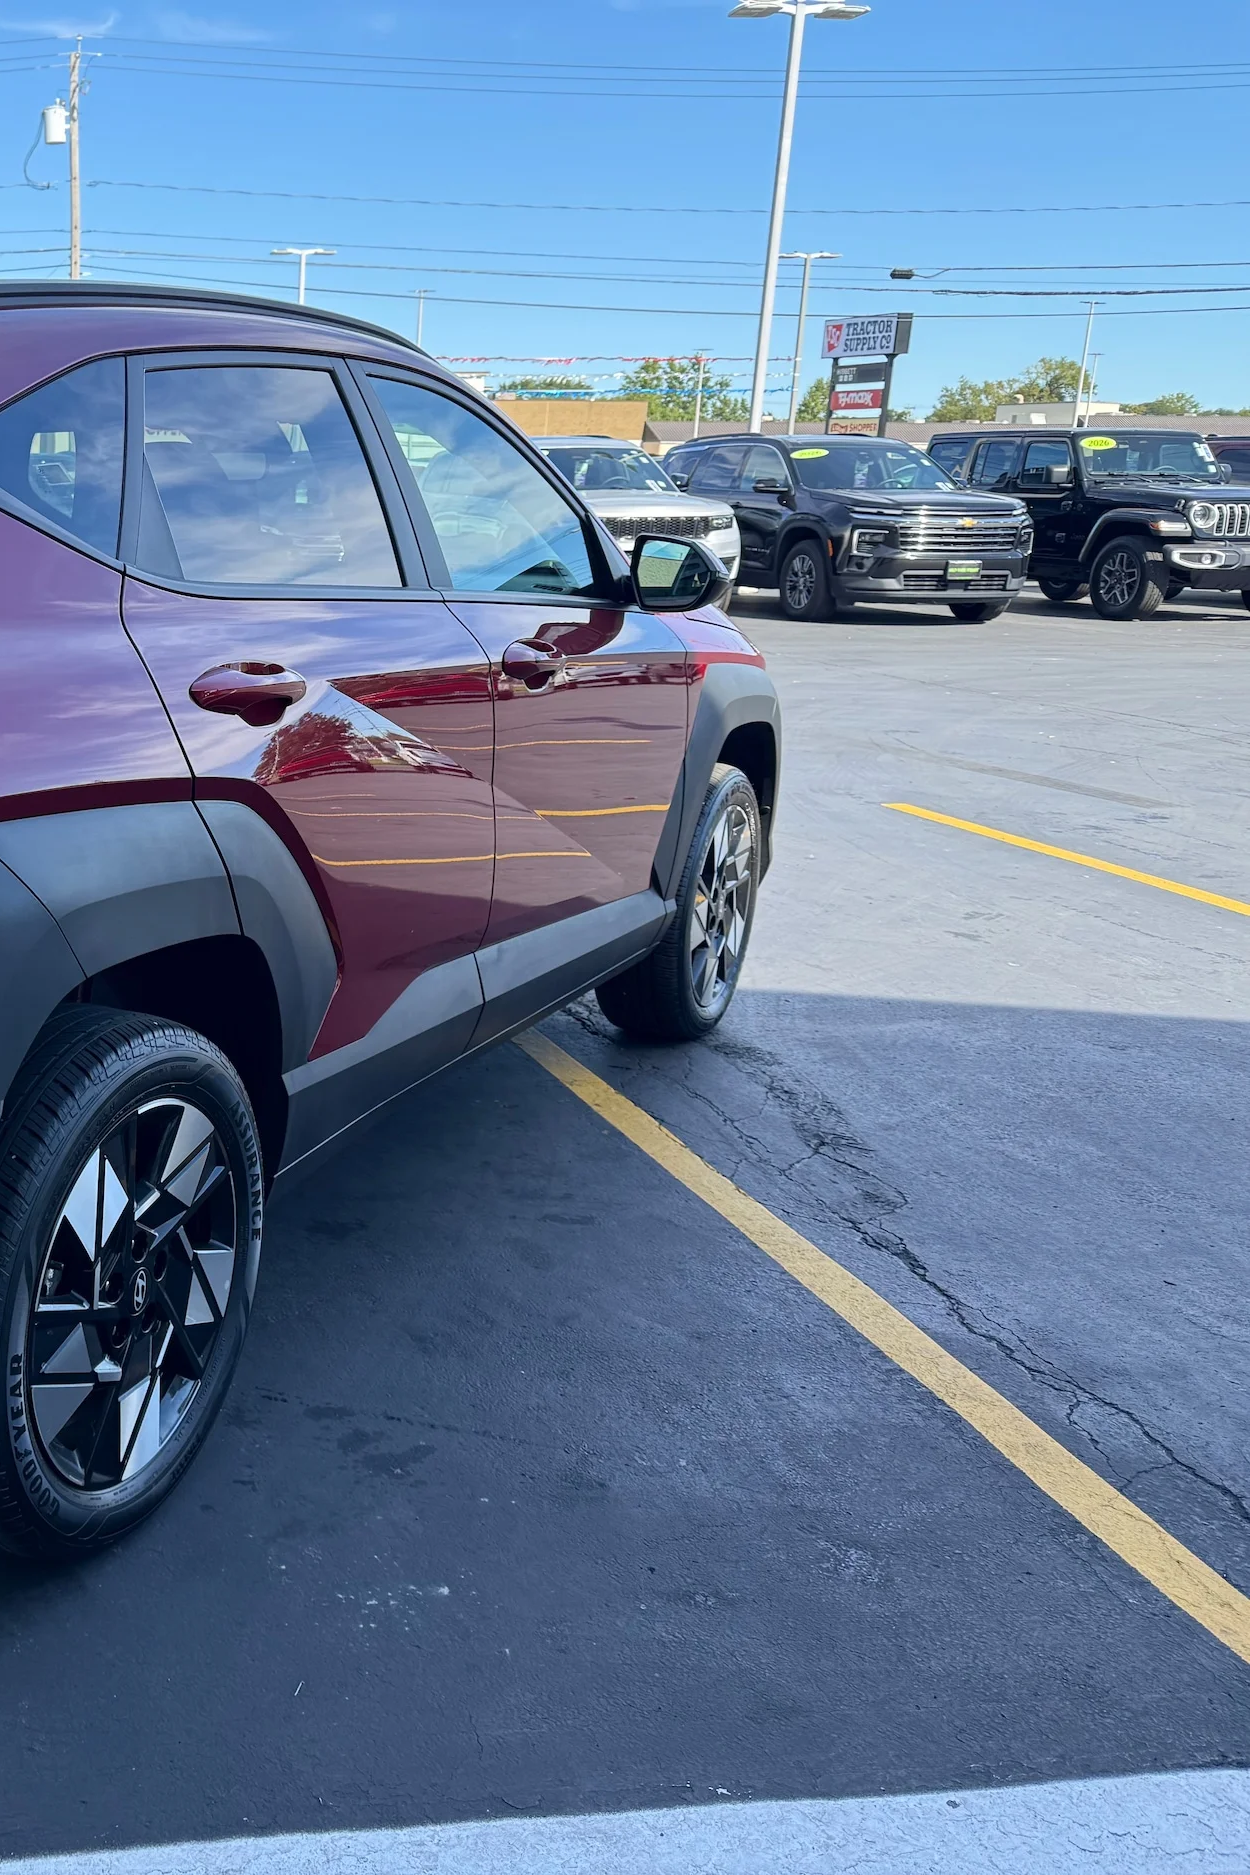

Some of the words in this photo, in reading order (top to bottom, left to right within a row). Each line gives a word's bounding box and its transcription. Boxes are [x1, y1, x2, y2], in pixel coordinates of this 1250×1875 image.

[843, 336, 878, 352] SUPPLY
[846, 320, 893, 337] TRACTOR
[229, 1100, 262, 1242] ASSURANCE
[10, 1353, 61, 1516] GOODYEAR
